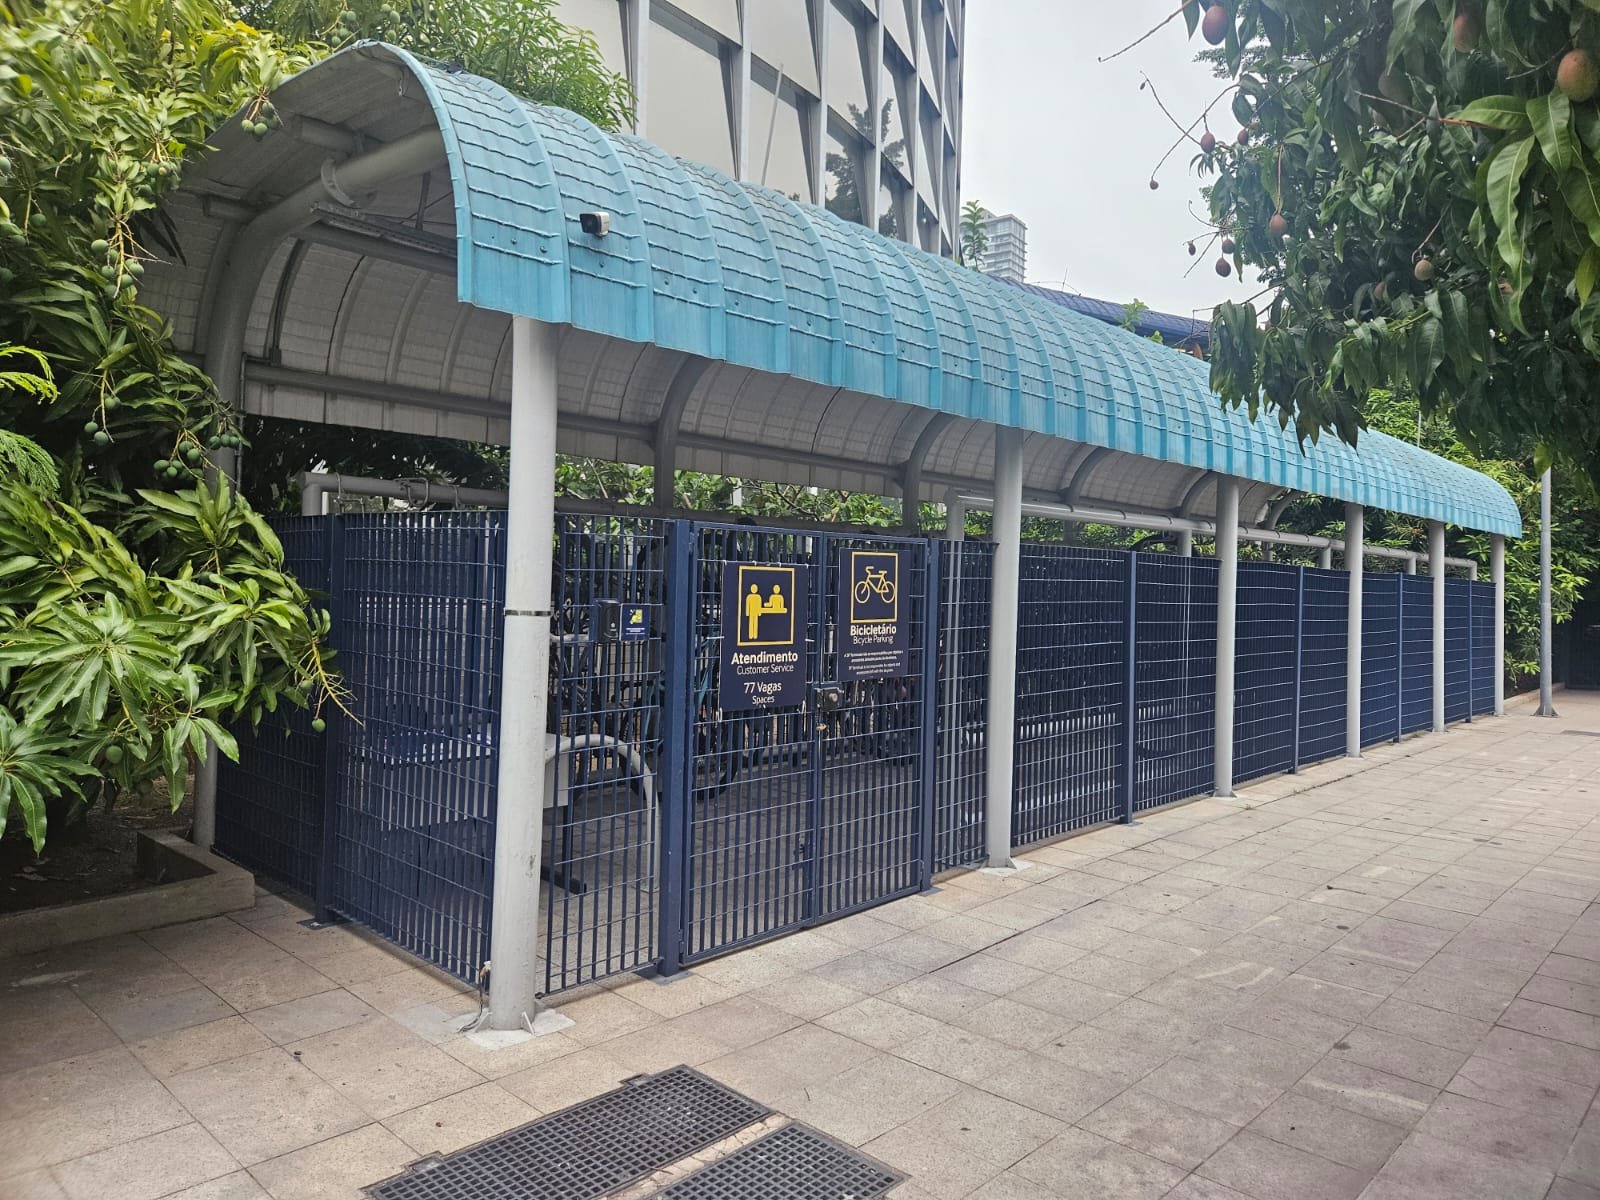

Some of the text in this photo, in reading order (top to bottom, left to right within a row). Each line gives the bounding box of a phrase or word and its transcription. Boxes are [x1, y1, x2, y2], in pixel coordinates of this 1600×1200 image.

[850, 623, 897, 636] Bicicletário
[853, 634, 894, 646] Bicycle Parking
[731, 650, 799, 665] Atendimento
[736, 663, 795, 675] Customer Service
[743, 681, 782, 695] 77 Vagas
[752, 695, 775, 706] Spaces
